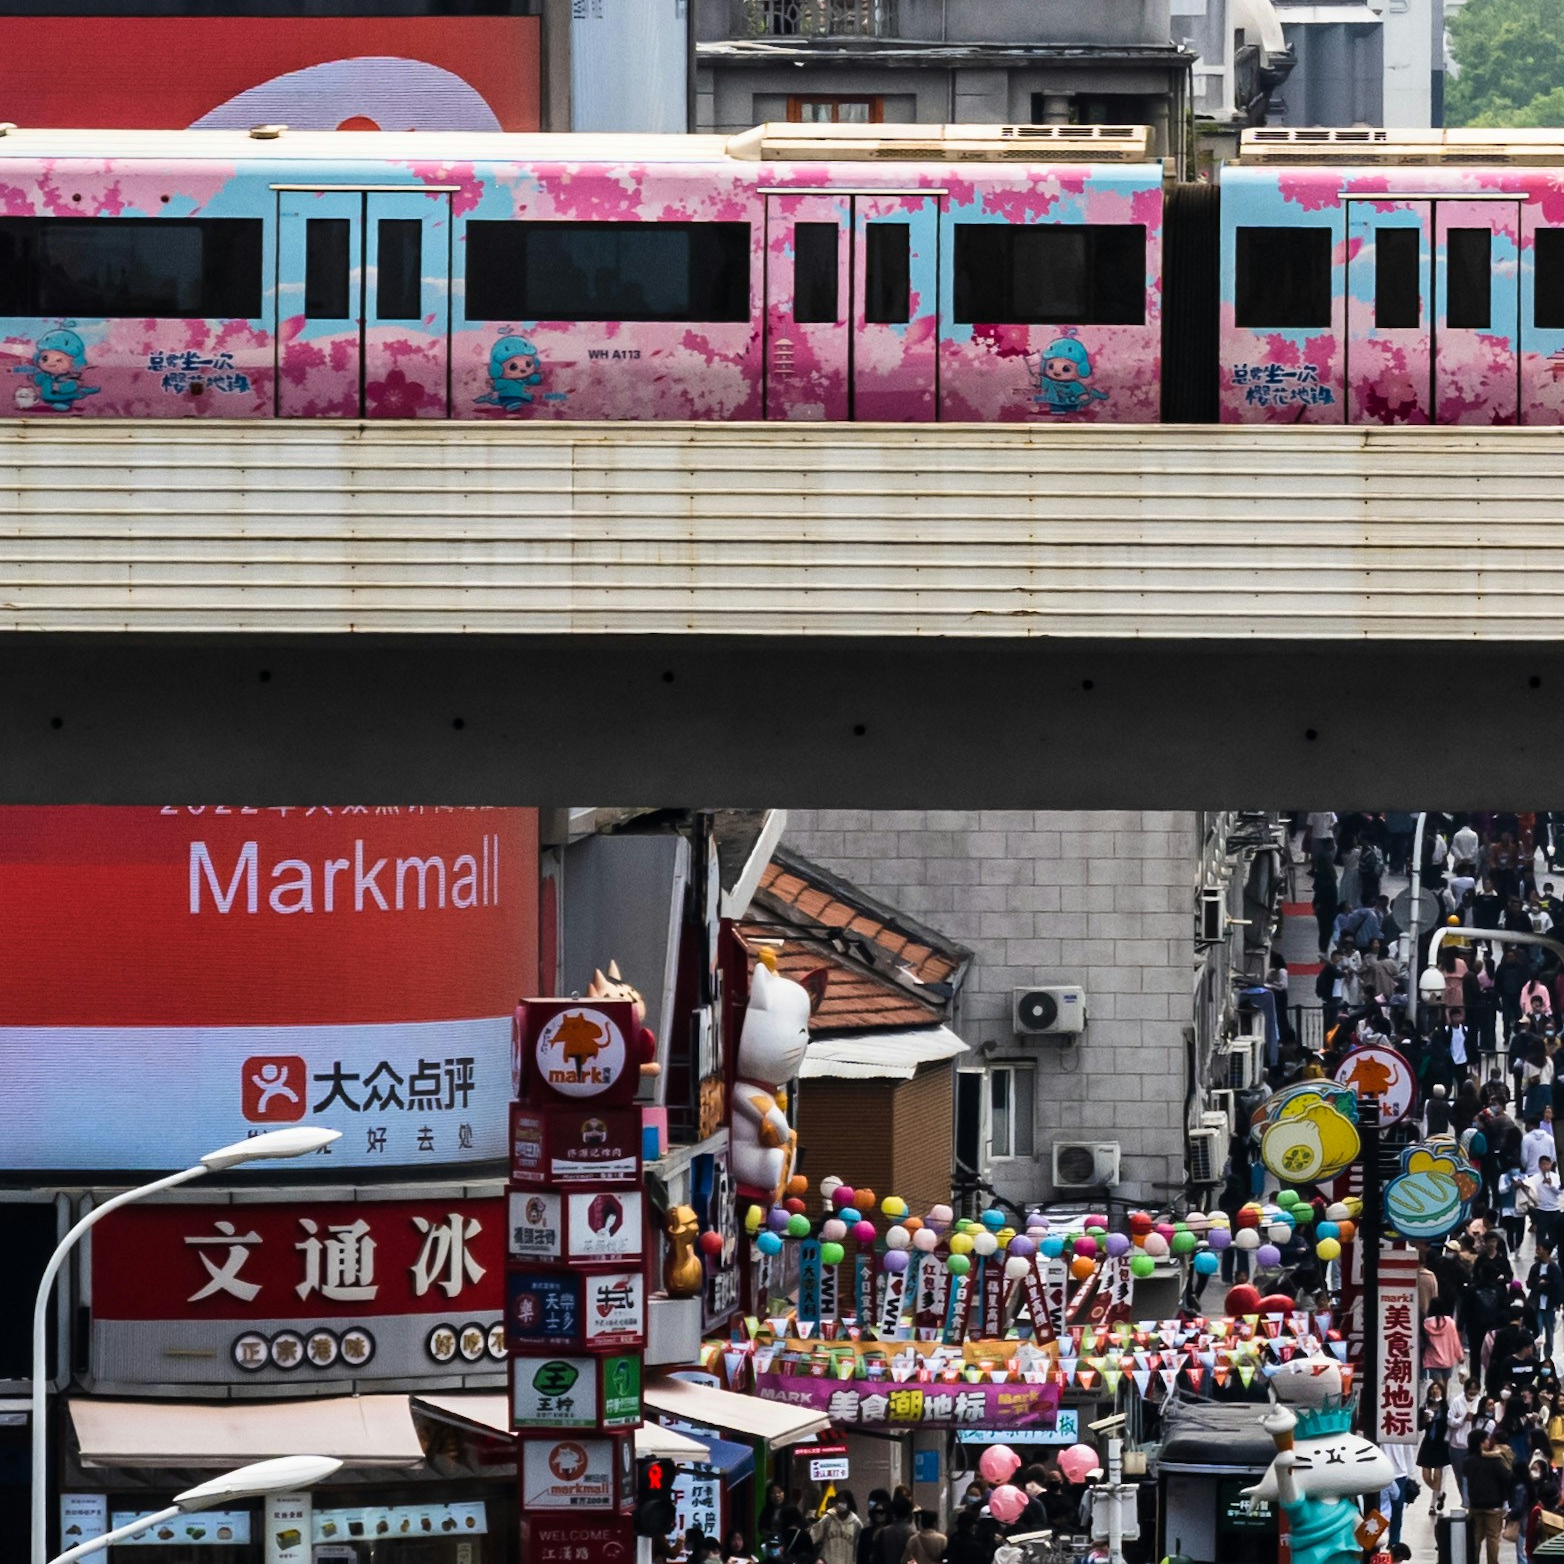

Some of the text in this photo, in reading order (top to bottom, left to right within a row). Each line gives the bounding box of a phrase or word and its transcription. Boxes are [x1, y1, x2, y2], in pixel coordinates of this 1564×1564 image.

[588, 349, 641, 360] WH A113
[189, 833, 499, 914] Markmall
[313, 1057, 475, 1114] 大众点评
[184, 1213, 487, 1302] 文通冰
[1381, 1305, 1414, 1438] 美食潮地标
[760, 1388, 813, 1403] MARK
[829, 1390, 986, 1423] 美食潮地标
[539, 1530, 610, 1541] WELCOME
